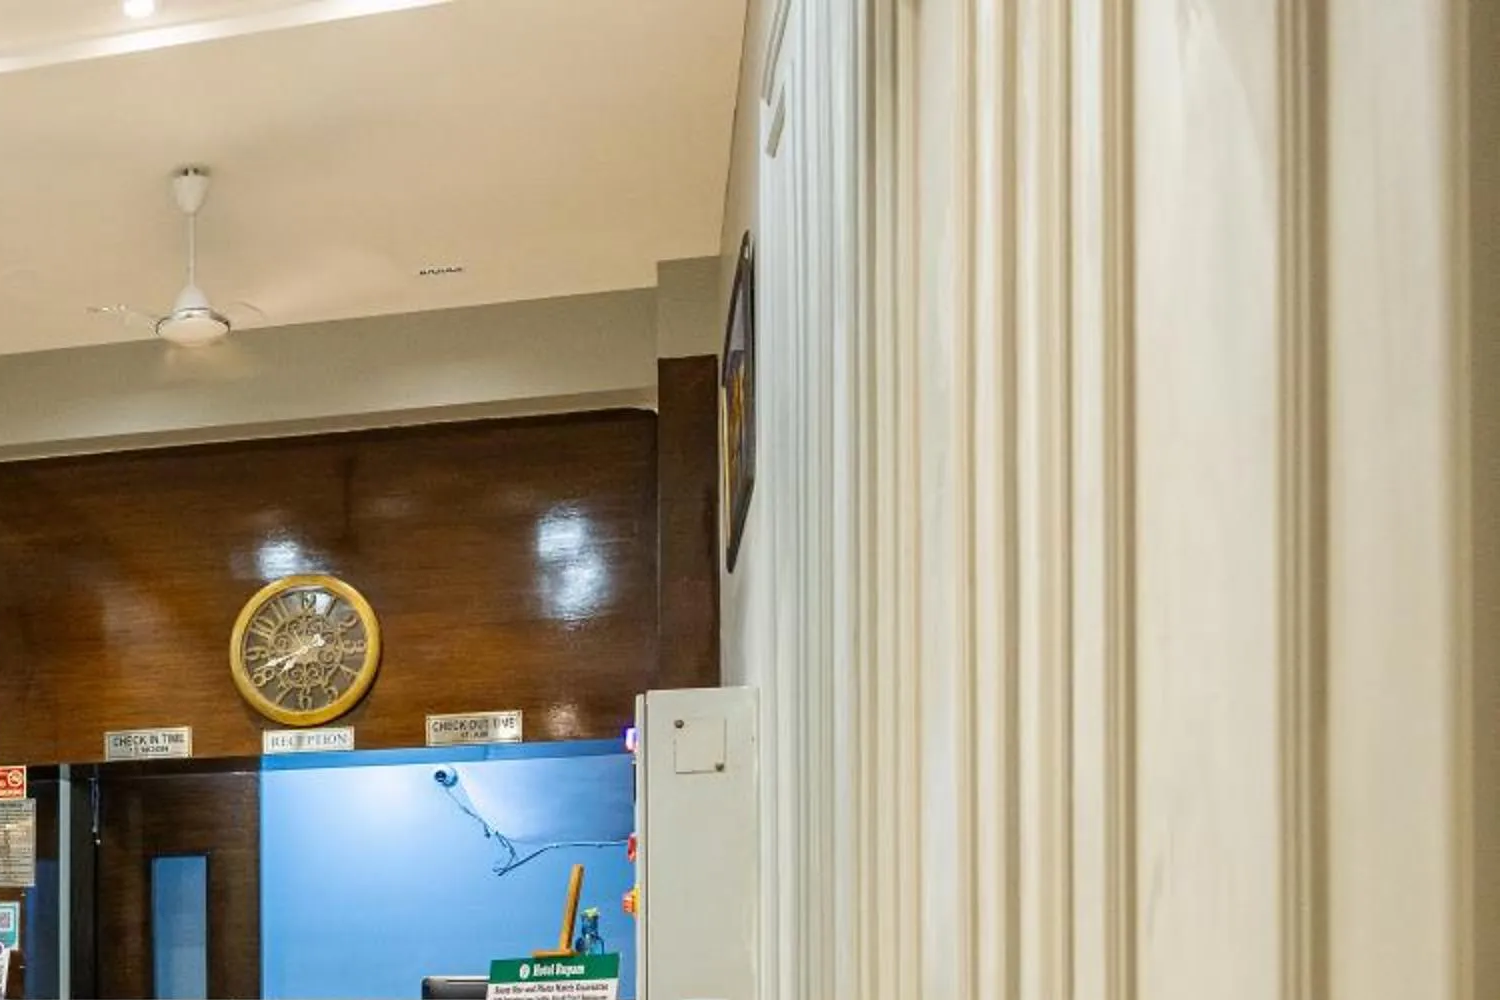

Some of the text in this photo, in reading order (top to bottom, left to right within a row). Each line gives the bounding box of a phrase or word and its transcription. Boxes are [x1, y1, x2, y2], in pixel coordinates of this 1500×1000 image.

[432, 719, 467, 732] CHECK
[492, 716, 515, 729] TME
[113, 733, 185, 747] CHECK IN TIME
[271, 732, 348, 749] RECPTION
[533, 963, 555, 977] Hotel
